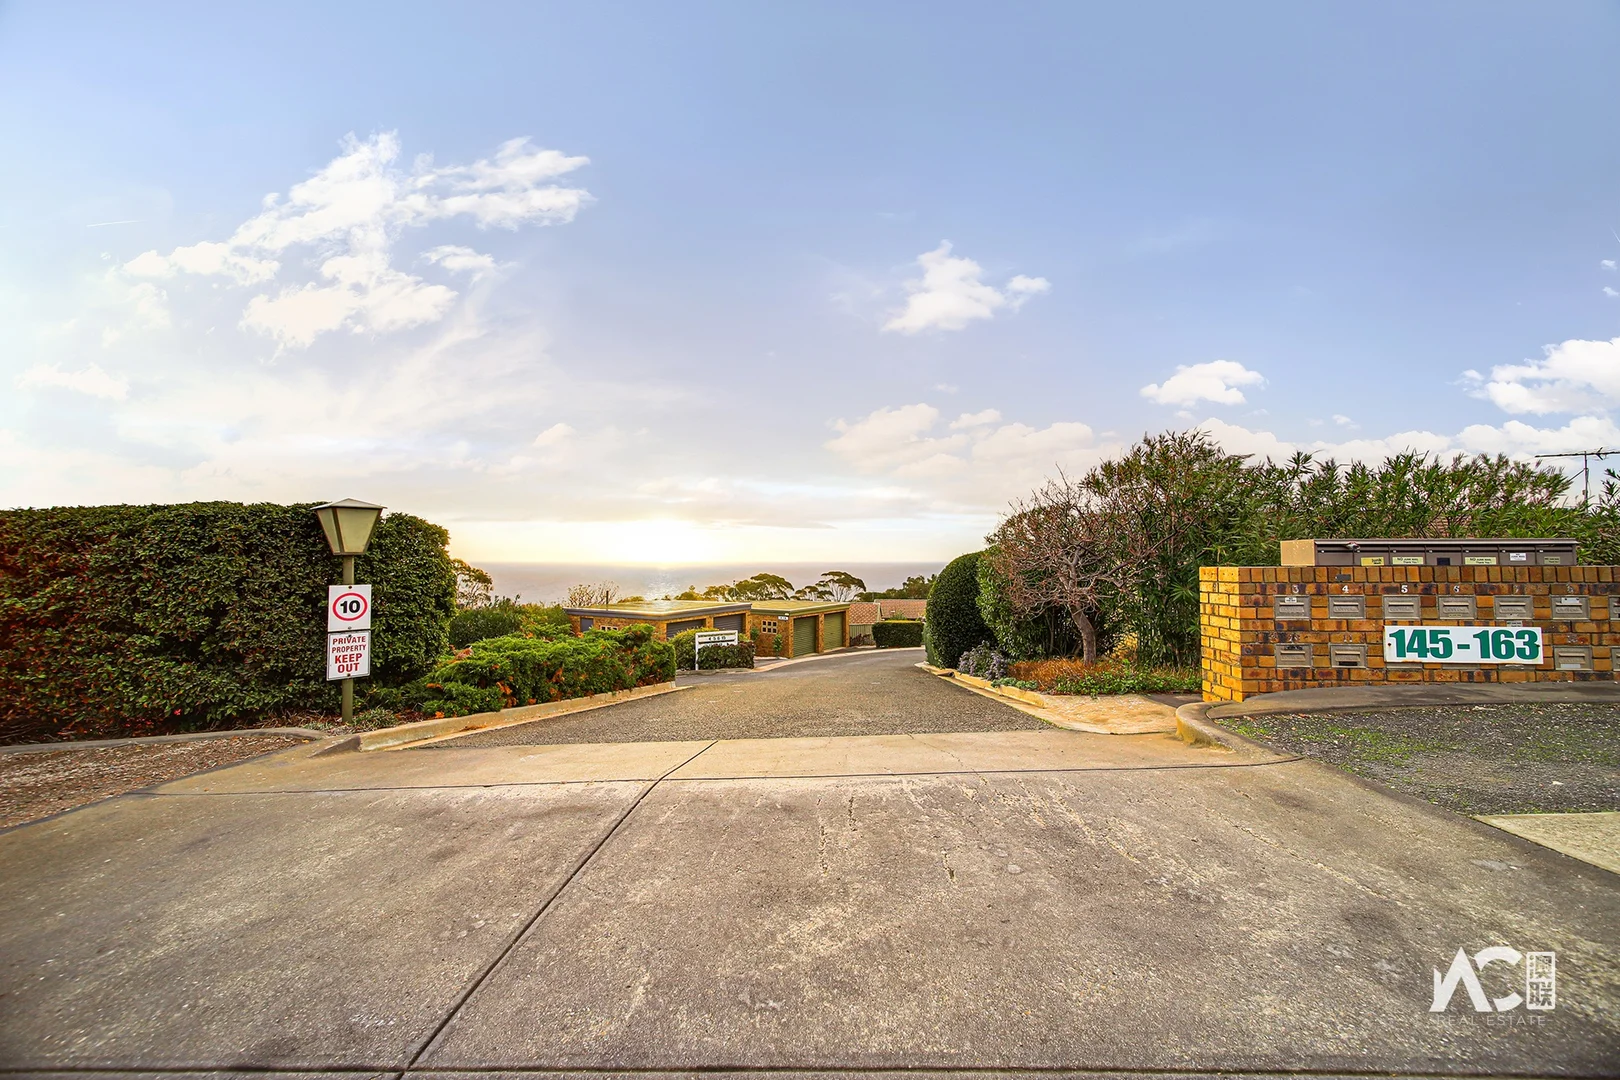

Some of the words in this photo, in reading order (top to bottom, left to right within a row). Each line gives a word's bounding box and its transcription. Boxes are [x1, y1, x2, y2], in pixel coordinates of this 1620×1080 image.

[1292, 584, 1299, 593] 3
[1342, 585, 1349, 593] 4
[1401, 585, 1408, 593] 5
[1453, 585, 1460, 593] 6
[340, 600, 361, 614] 10
[332, 635, 367, 645] PRIVATE
[331, 644, 367, 654] PROPERTY
[334, 653, 363, 665] KEEP
[337, 662, 360, 674] OUT
